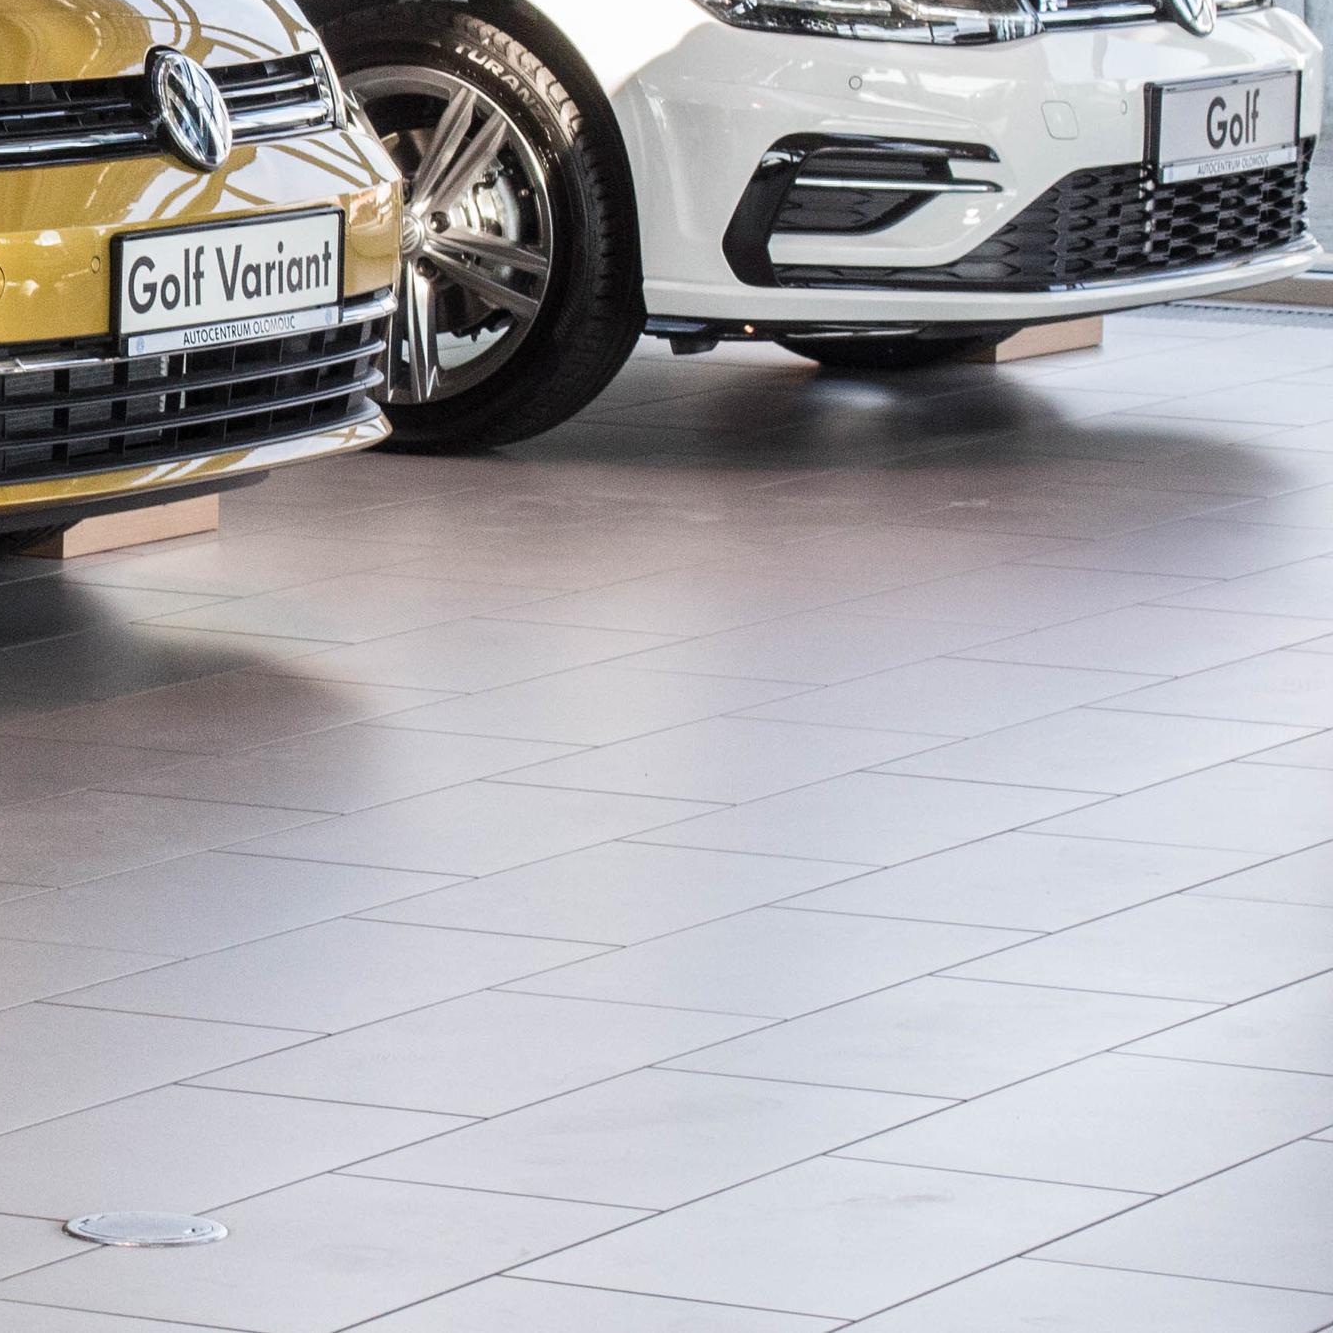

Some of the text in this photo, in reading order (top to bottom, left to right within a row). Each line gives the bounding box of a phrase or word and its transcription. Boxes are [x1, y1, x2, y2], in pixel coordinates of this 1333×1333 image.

[1206, 88, 1260, 150] Golf
[127, 240, 332, 315] Golf Variant
[183, 315, 296, 346] AUTOCENTRUM OLOMOUC
